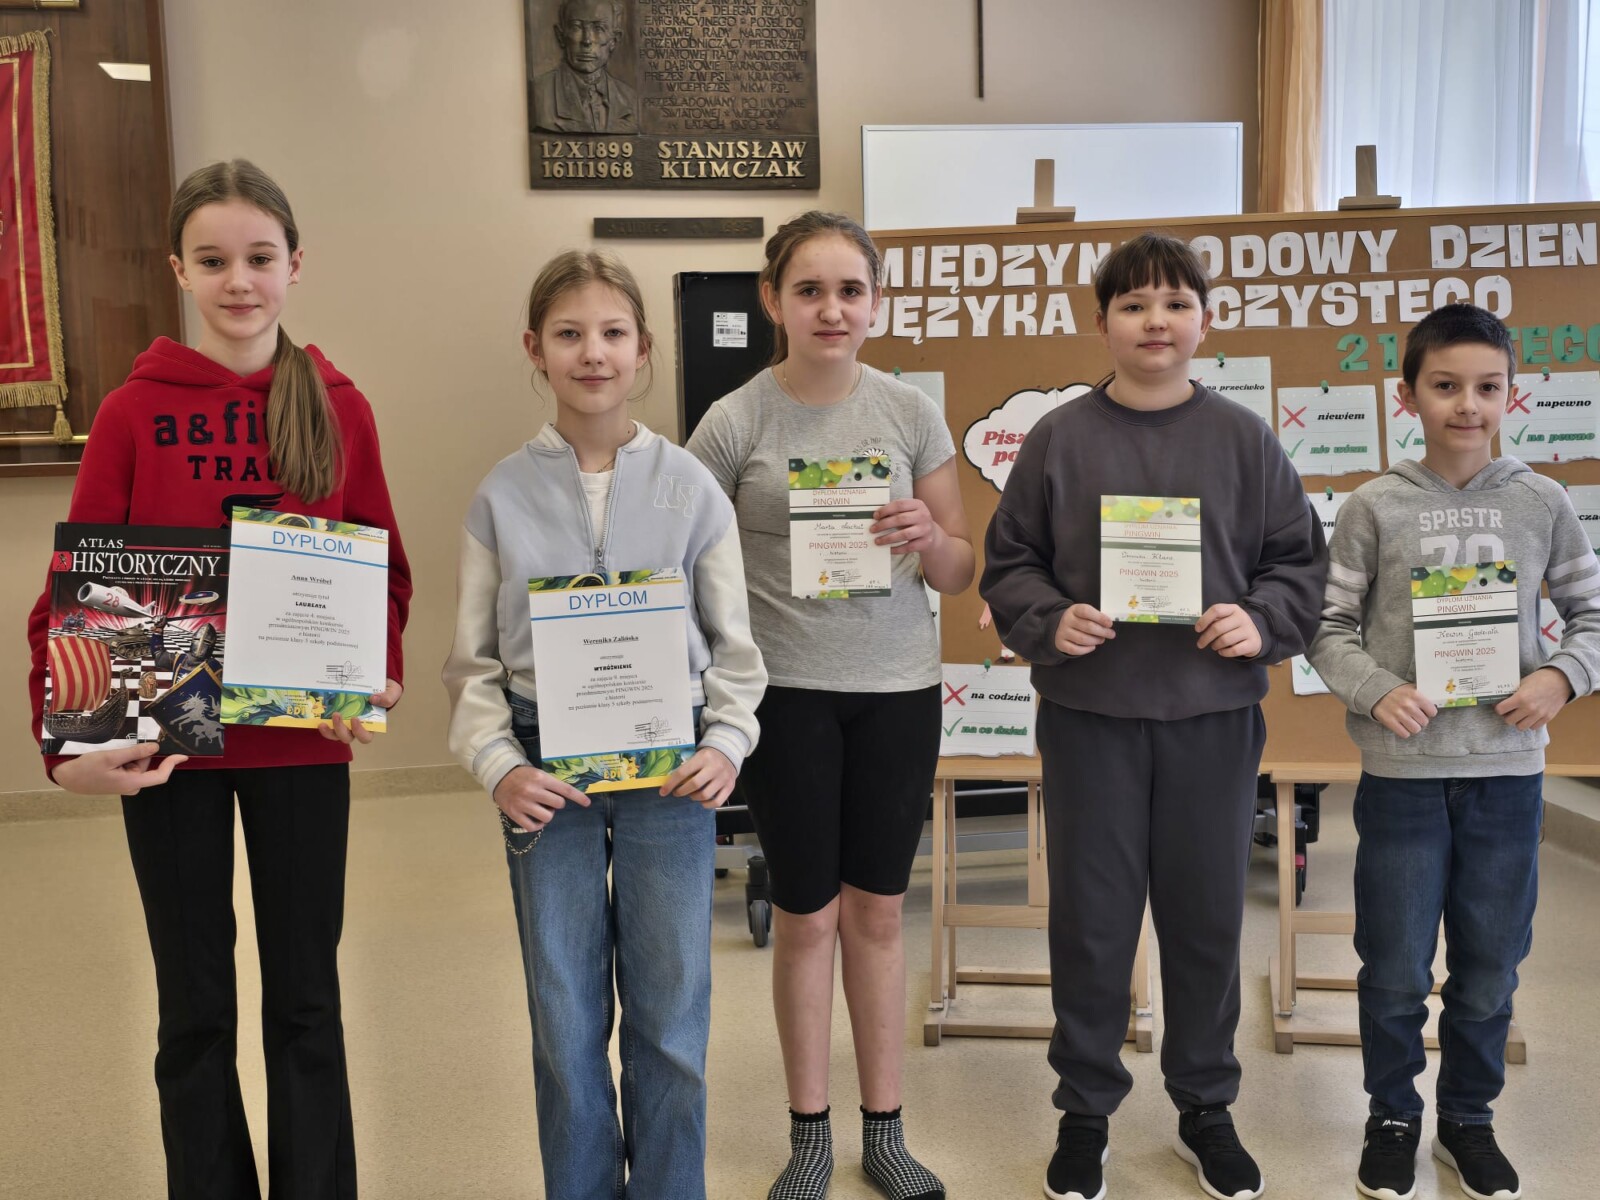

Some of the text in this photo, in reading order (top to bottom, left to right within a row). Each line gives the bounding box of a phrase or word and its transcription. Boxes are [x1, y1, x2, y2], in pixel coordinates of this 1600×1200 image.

[658, 141, 806, 160] STANISŁAW
[661, 161, 806, 179] KLIMCZAK
[1336, 334, 1398, 372] 21
[1536, 400, 1592, 408] napewno
[1318, 412, 1366, 420] niewiem
[1527, 432, 1596, 444] na pewno
[1419, 508, 1503, 532] SPRSTR
[78, 538, 124, 549] ATLAS
[273, 530, 352, 555] DYPLOM
[72, 551, 220, 576] HISTORYCZNY
[1120, 568, 1156, 576] PINGWIN
[102, 592, 120, 608] 28
[569, 590, 647, 610] DYPLOM
[1437, 604, 1476, 614] PINGWIN
[1434, 647, 1496, 658] PINGWIN 2025
[988, 692, 1030, 702] codzień
